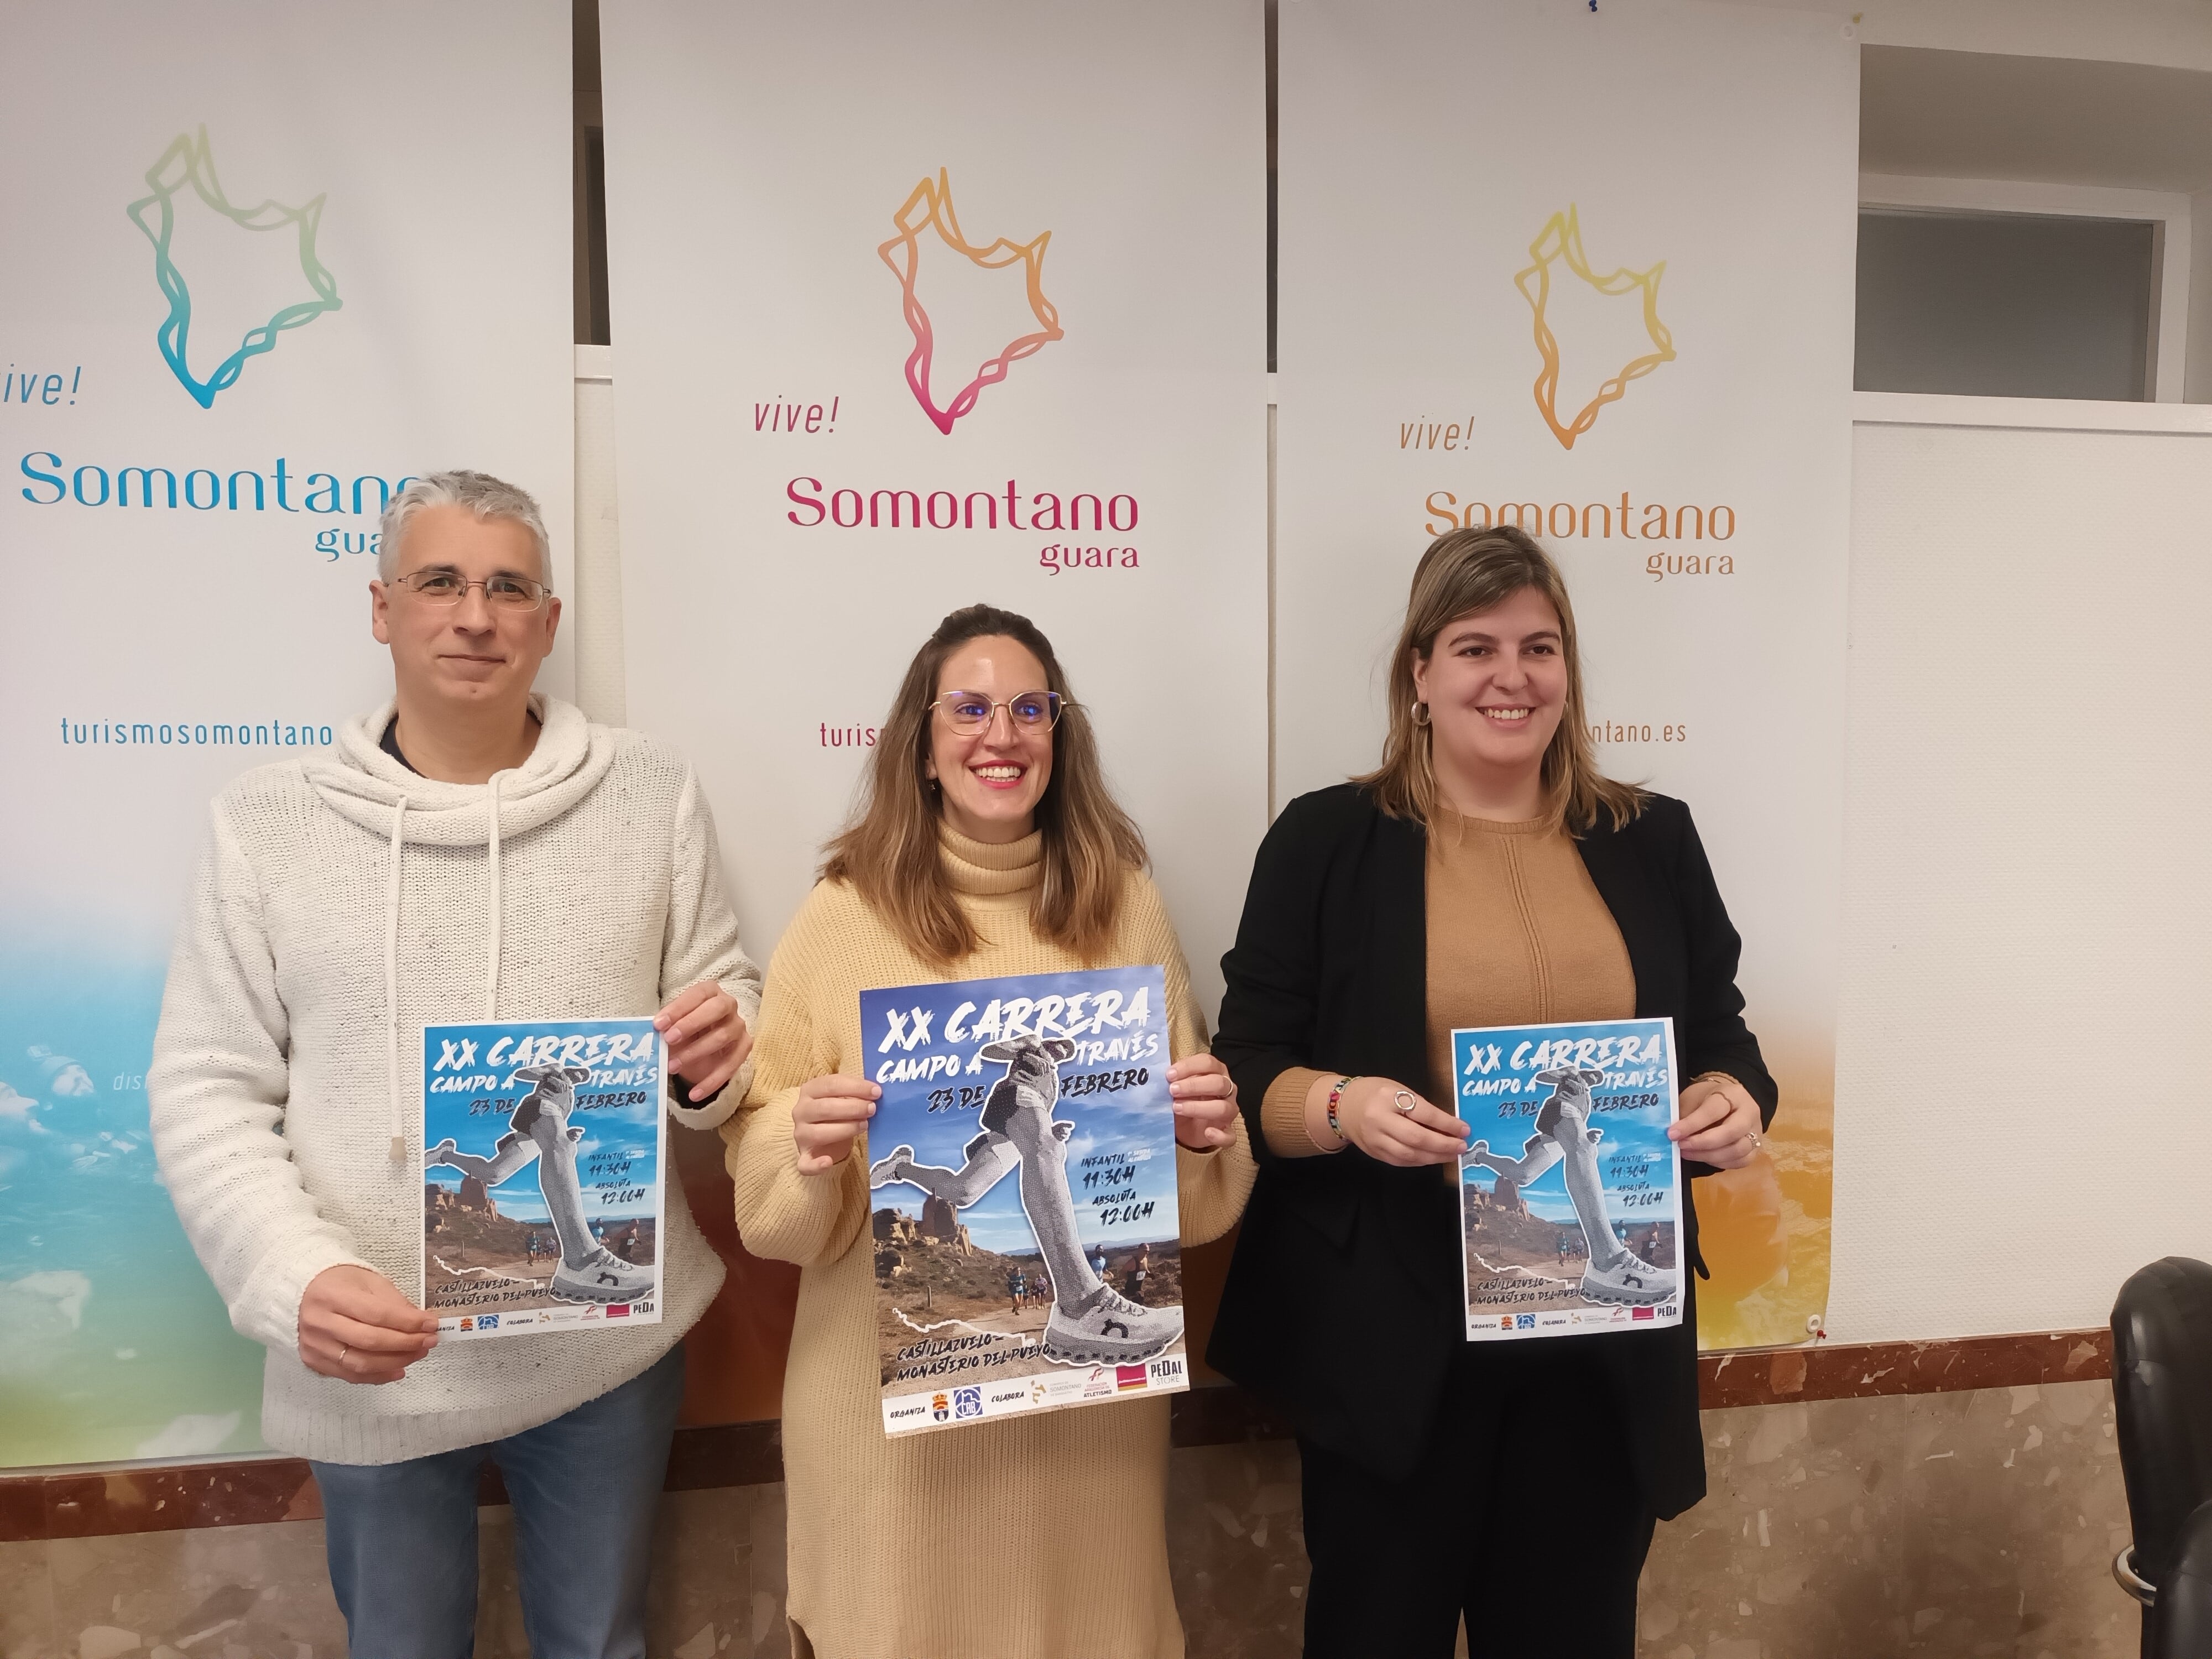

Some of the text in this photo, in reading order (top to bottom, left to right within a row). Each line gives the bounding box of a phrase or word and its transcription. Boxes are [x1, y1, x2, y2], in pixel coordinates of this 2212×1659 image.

[0, 363, 81, 405] ive!
[754, 394, 839, 434] vive!
[1400, 415, 1474, 451] vive!
[786, 477, 1139, 531] Somontano
[1425, 491, 1736, 540] Somontano
[315, 528, 383, 562] gua
[1039, 544, 1140, 576] guara
[1646, 552, 1735, 582] guara
[61, 717, 332, 745] turismosomontano
[820, 723, 885, 747] turis
[1593, 720, 1686, 743] ntano.es
[878, 987, 1150, 1053] XX CARRERA
[433, 1032, 654, 1071] XX CARRERA
[876, 1030, 1159, 1084] CAMPO A TRAVÉS
[1464, 1035, 1662, 1076] XX CARRERA
[113, 1072, 147, 1091] dis
[430, 1064, 658, 1093] CAMPO A TRAVÉS
[926, 1067, 1149, 1114] 23 DE FEBRERO
[1462, 1067, 1668, 1097] CAMPO A TRAVÉS
[468, 1091, 646, 1117] 23 DE FEBRERO
[1498, 1093, 1659, 1119] 23 DE FEBRERO
[588, 1152, 623, 1162] INFANTIL
[589, 1161, 632, 1177] 11:30H
[1081, 1154, 1125, 1168] INFANTIL
[596, 1178, 631, 1190] ABSOLUTA
[1083, 1165, 1136, 1190] 11:30H
[1617, 1181, 1650, 1192] ABSOLUTA
[601, 1188, 646, 1205] 12:00H
[1092, 1188, 1136, 1206] ABSOLUTA
[1100, 1201, 1155, 1227] 12:00H
[434, 1292, 499, 1308] MONASTERIO
[633, 1302, 654, 1314] PEDA
[1477, 1291, 1535, 1305] MONASTERIO
[1657, 1306, 1677, 1317] PEDA
[896, 1355, 979, 1381] MONASTERIO
[1151, 1360, 1182, 1378] PEDAL
[1156, 1375, 1181, 1385] STORE
[991, 1391, 1024, 1403] COLABORA
[1050, 1383, 1082, 1392] SOMONTANO
[890, 1406, 926, 1419] ORGANIZA
[962, 1401, 975, 1415] CAB
